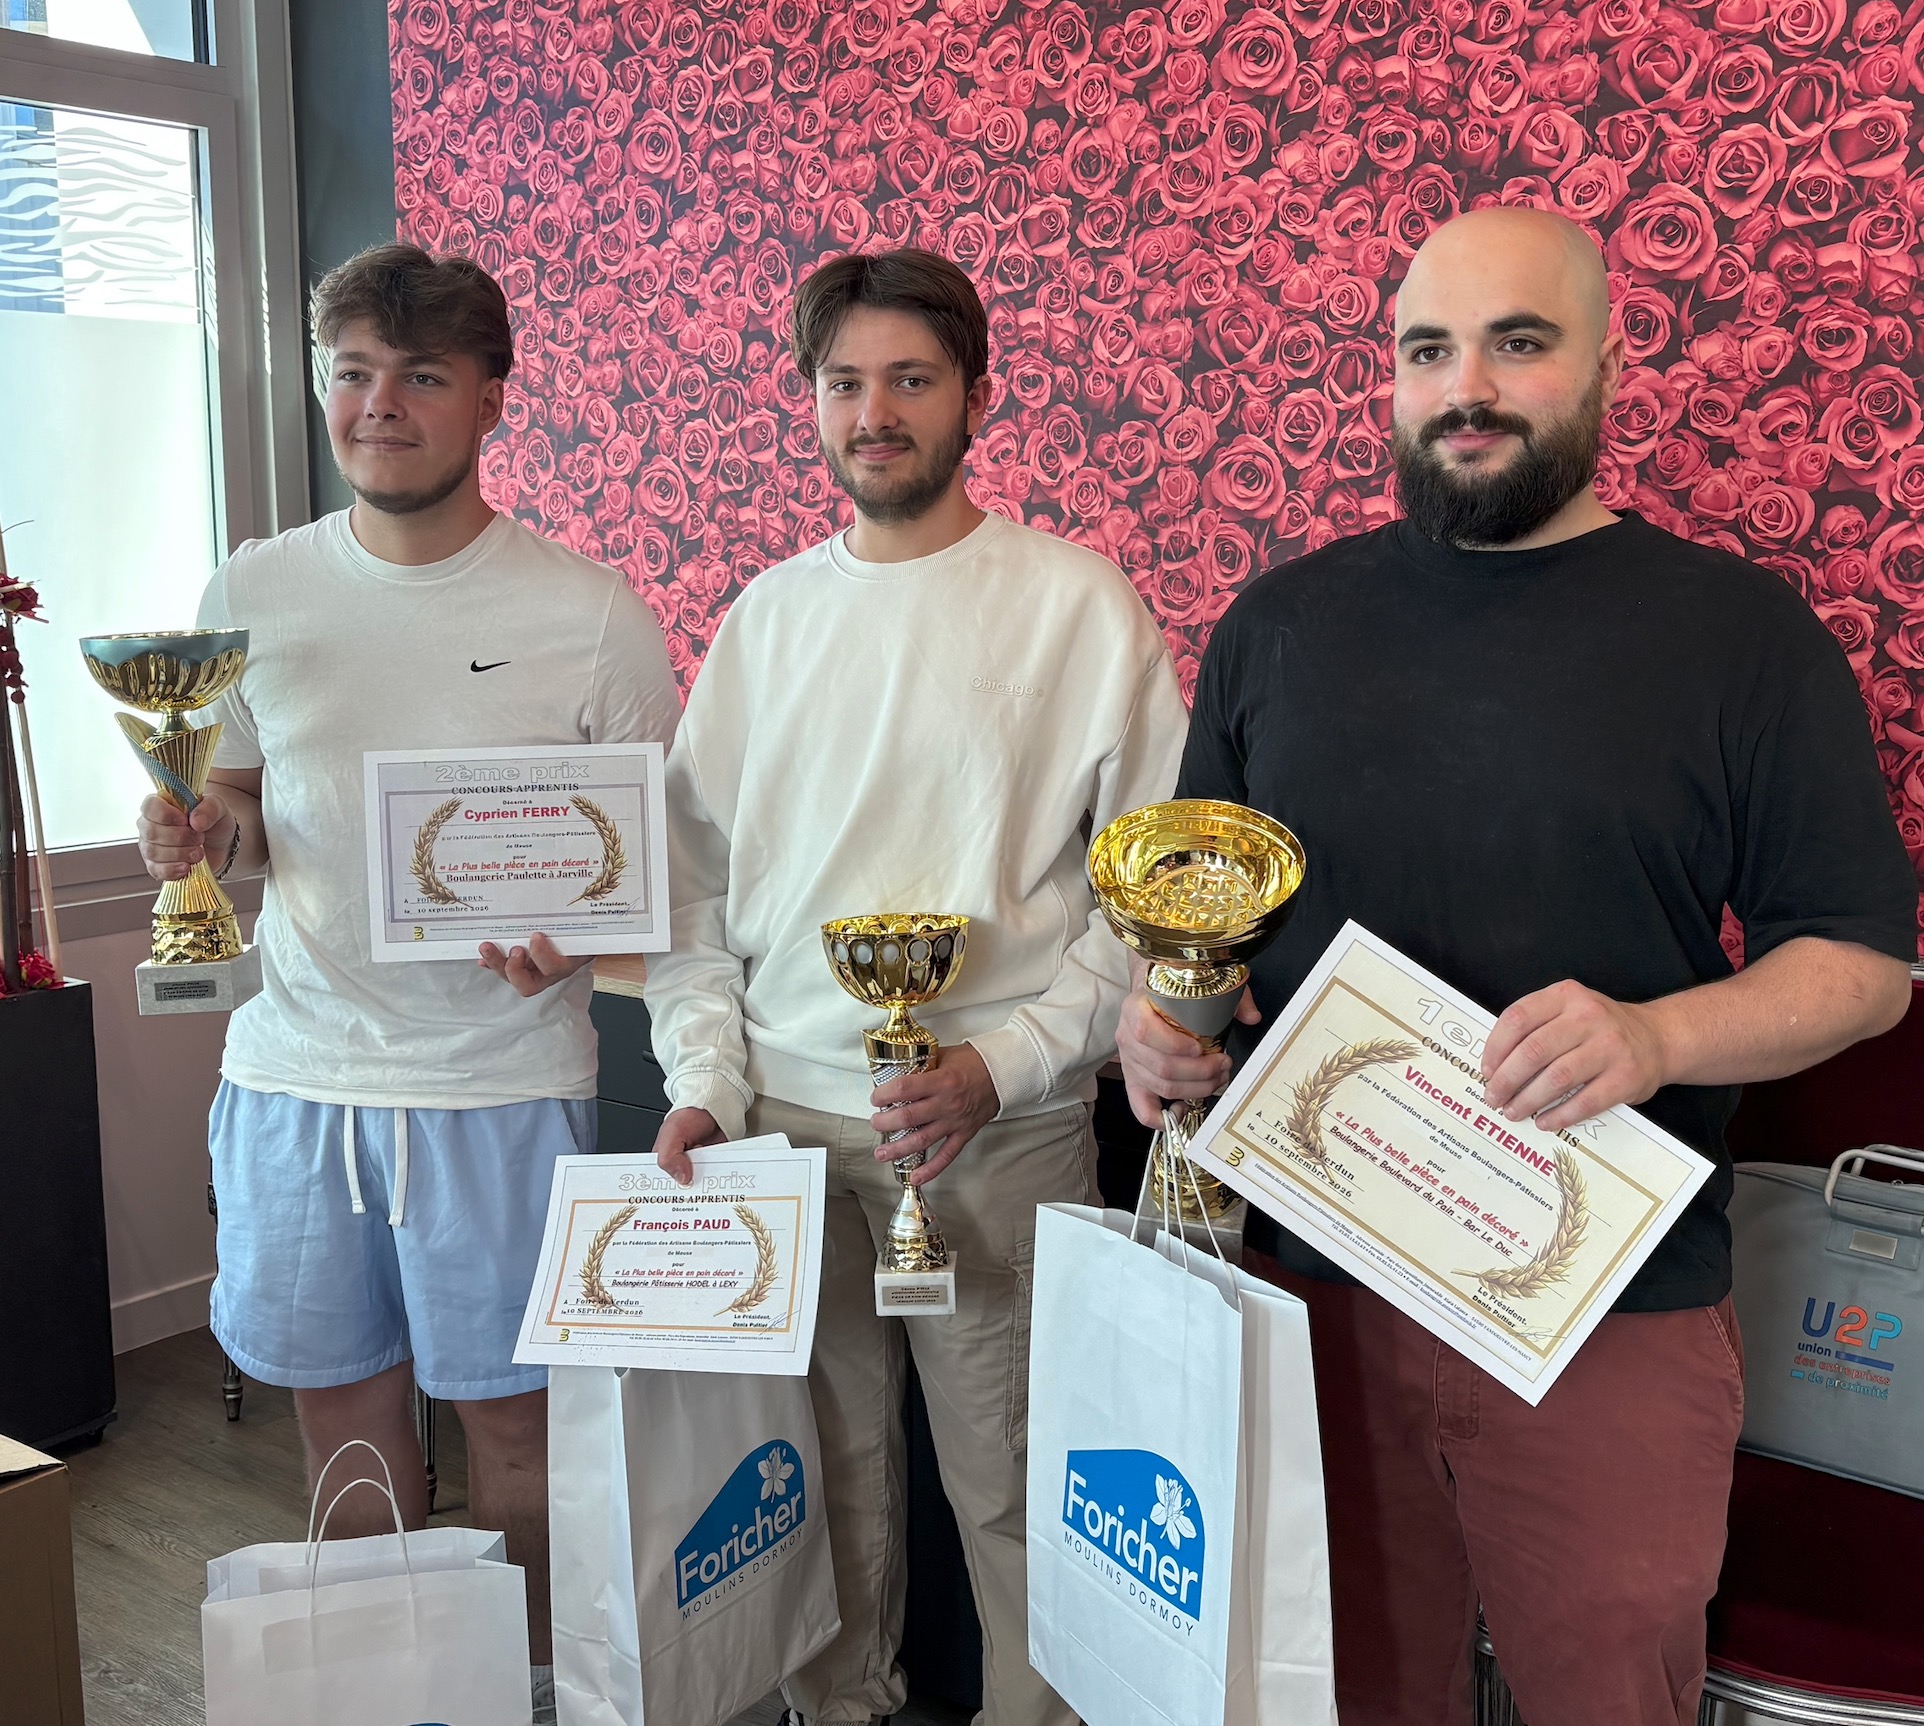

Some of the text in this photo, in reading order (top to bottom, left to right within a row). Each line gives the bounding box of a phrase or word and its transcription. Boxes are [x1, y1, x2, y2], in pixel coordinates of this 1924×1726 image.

[971, 676, 1034, 696] Chicago
[435, 761, 590, 783] 2ème prix
[451, 783, 579, 795] CONCOURS APPRENTIS
[464, 806, 570, 822] Cyprien FERRY
[446, 872, 505, 883] Boulangerie
[507, 871, 547, 881] Paulette
[556, 869, 593, 879] Jarville
[449, 863, 458, 871] La
[461, 862, 478, 871] Plus
[481, 861, 501, 870] belle
[541, 859, 559, 870] pain
[428, 906, 468, 914] septembre
[1420, 1034, 1490, 1087] CONCOUR
[1356, 1073, 1372, 1084] par
[1371, 1081, 1380, 1091] la
[1380, 1087, 1421, 1120] Fédération
[1421, 1118, 1437, 1130] des
[1436, 1128, 1470, 1153] Artisans
[1405, 1065, 1471, 1119] Vincent
[1473, 1114, 1556, 1176] ETIENNE
[1273, 1119, 1302, 1143] Foire
[1302, 1140, 1316, 1153] de
[1318, 1150, 1356, 1180] Verdun
[1428, 1135, 1462, 1160] de Meuse
[1264, 1133, 1278, 1145] 10
[1278, 1143, 1328, 1181] septembre
[1328, 1177, 1353, 1198] 2026
[1425, 1159, 1446, 1173] pour
[702, 1171, 756, 1193] prix
[1344, 1115, 1359, 1131] La
[1360, 1126, 1383, 1146] Plus
[1383, 1142, 1410, 1165] belle
[1408, 1163, 1439, 1188] pièce
[1440, 1185, 1456, 1197] en
[1453, 1195, 1480, 1216] pain
[1480, 1212, 1520, 1240] décoré
[628, 1194, 746, 1204] CONCOURS APPRENTIS
[1328, 1125, 1378, 1163] Boulangerie
[1379, 1159, 1423, 1192] Boulevard
[1422, 1191, 1435, 1202] du
[1434, 1199, 1454, 1216] Pain
[1462, 1218, 1480, 1232] Bar
[1480, 1230, 1493, 1243] Le
[1494, 1240, 1512, 1257] Duc
[633, 1219, 731, 1232] François PAUD
[611, 1279, 649, 1288] Boulangerie
[651, 1279, 684, 1288] Pâtisserie
[685, 1280, 711, 1288] HODEL
[719, 1280, 739, 1288] LEXY
[665, 1269, 684, 1278] pièce
[695, 1270, 711, 1278] pain
[712, 1269, 736, 1277] décoré
[1476, 1286, 1488, 1297] Le
[1801, 1297, 1903, 1351] U2P
[1798, 1341, 1832, 1357] union
[1794, 1353, 1891, 1386] des entreprises
[1808, 1371, 1889, 1400] de proximité
[680, 1491, 802, 1600] Foricher
[1066, 1469, 1199, 1604] Foricher
[682, 1527, 803, 1621] MOULINS DORMOY
[1064, 1531, 1194, 1637] MOULINS DORMOY
